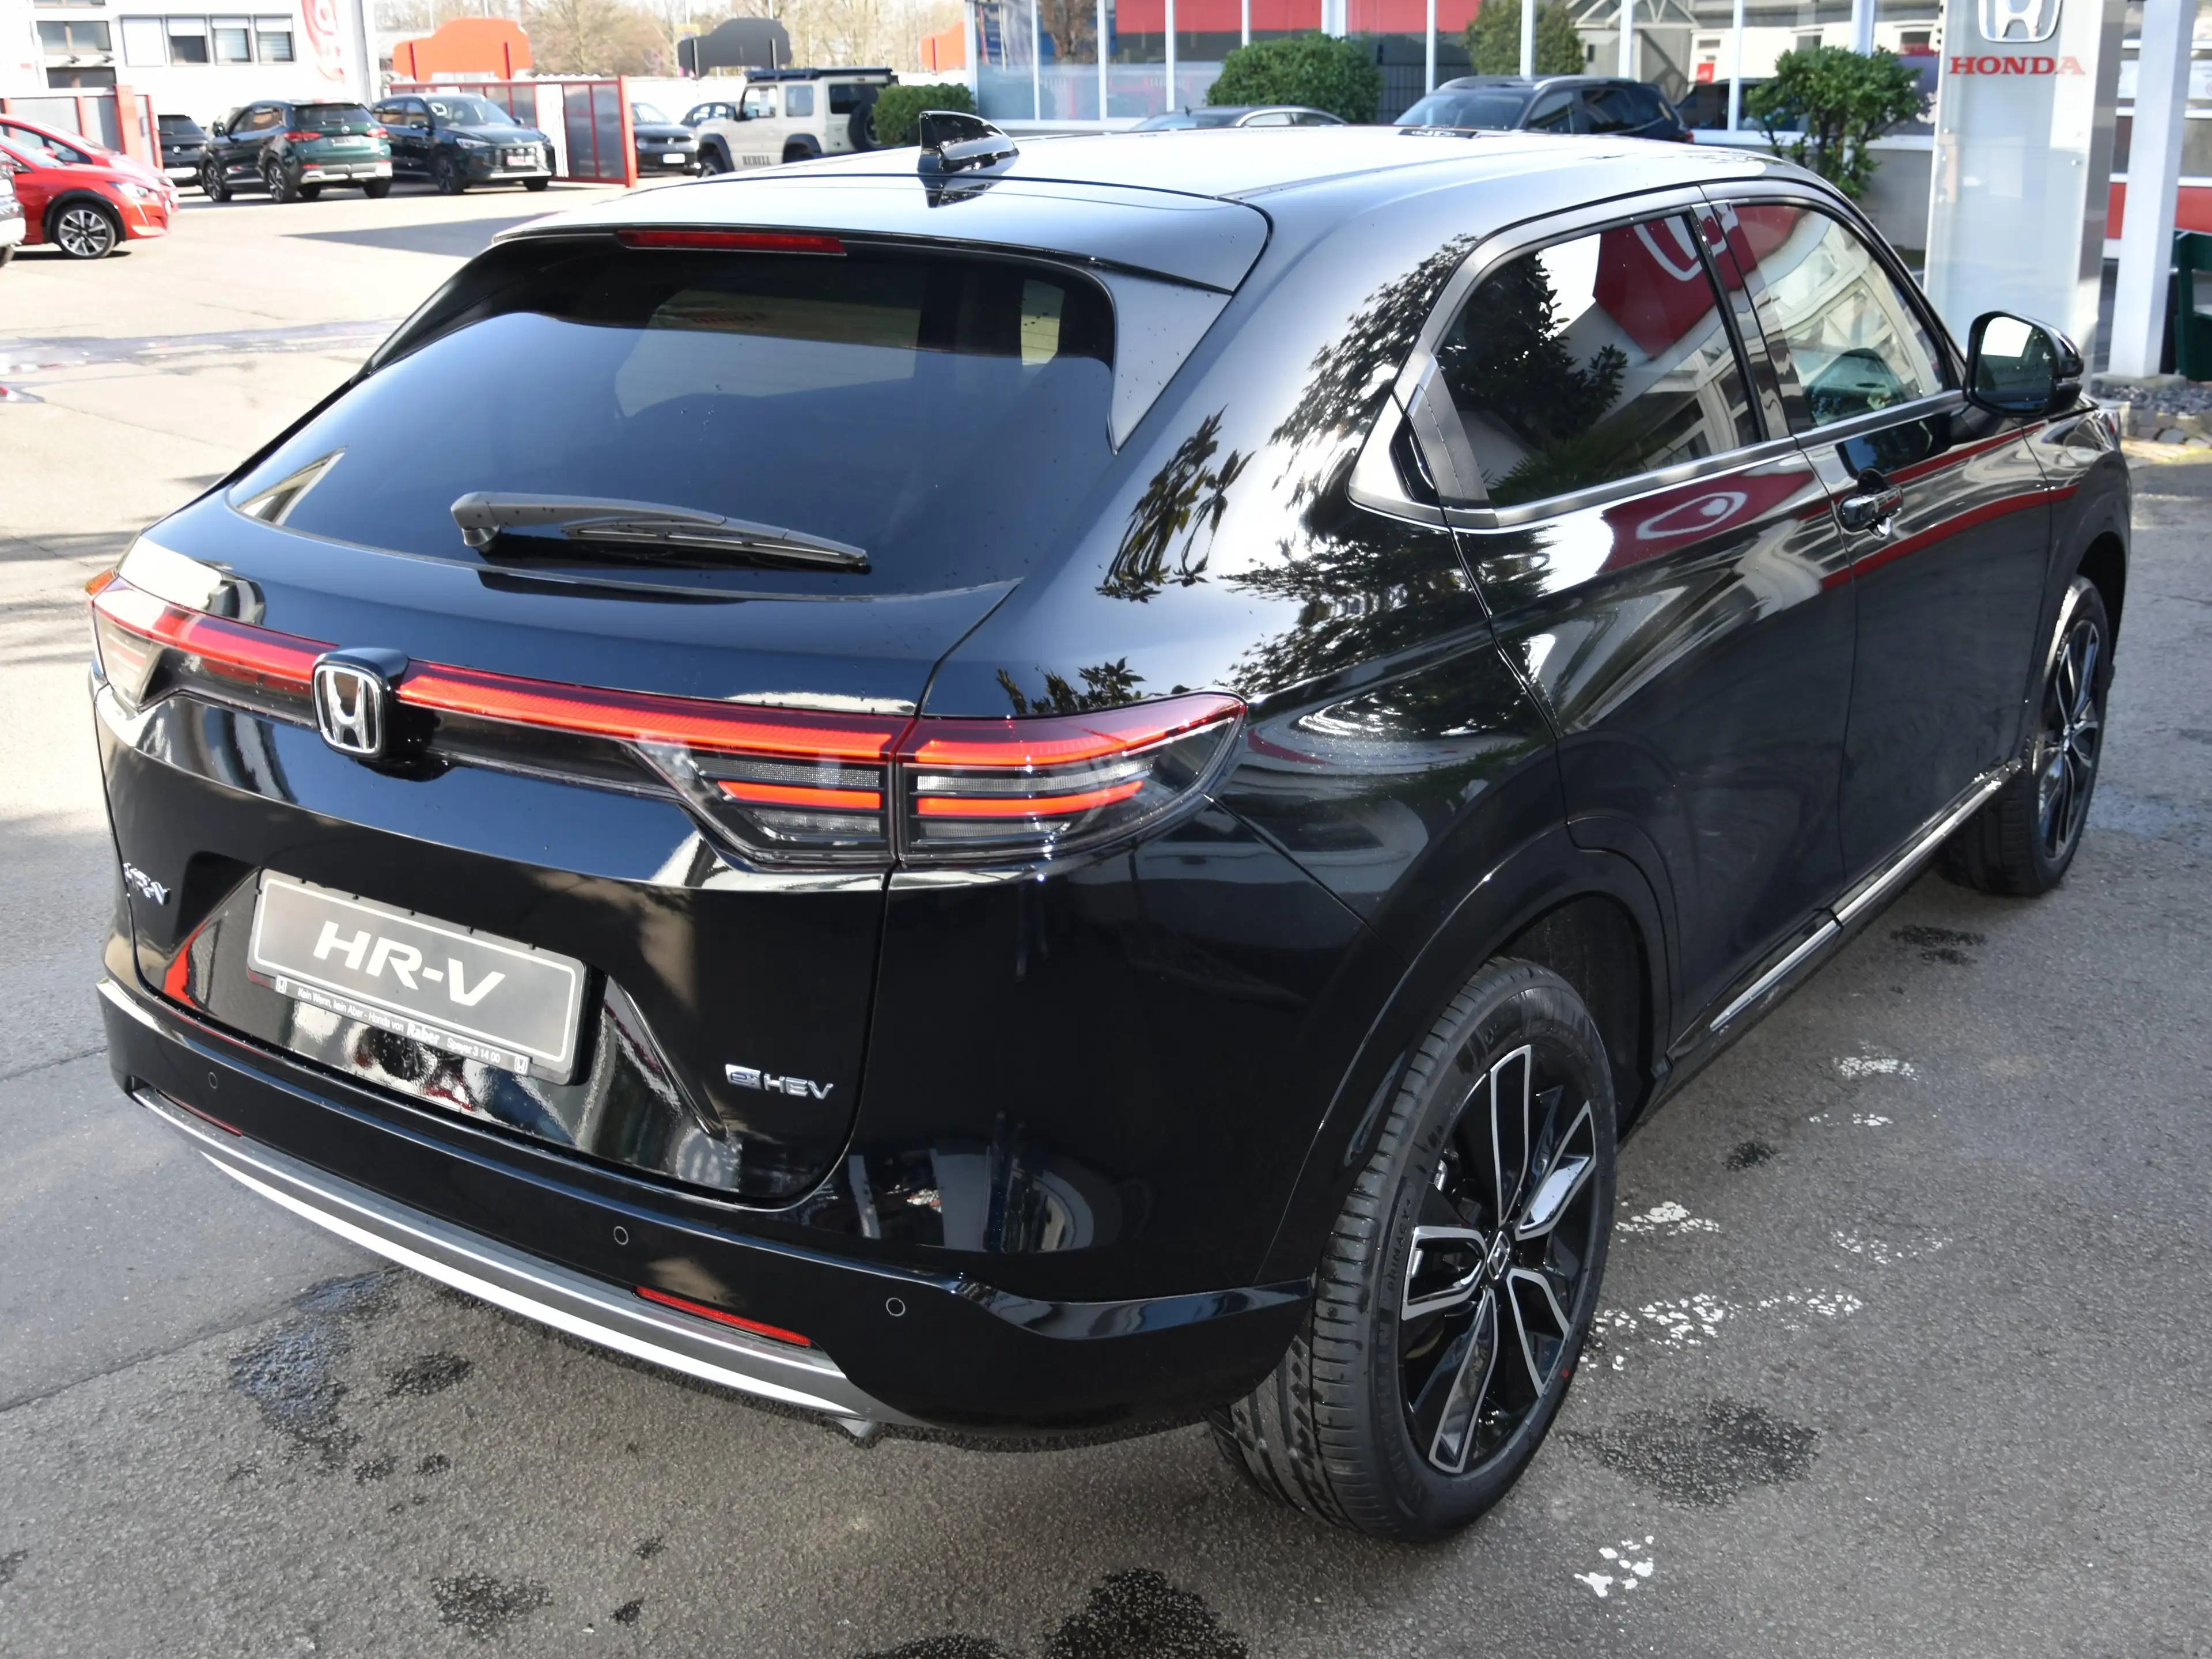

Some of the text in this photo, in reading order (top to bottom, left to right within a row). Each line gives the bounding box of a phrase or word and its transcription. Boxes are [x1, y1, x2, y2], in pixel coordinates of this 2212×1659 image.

[1949, 56, 2085, 75] HONDA
[313, 920, 506, 1006] HR-V
[298, 987, 312, 1001] Kein
[313, 991, 332, 1007] Wenn,
[334, 999, 347, 1013] kein
[347, 1004, 363, 1018] Aber
[369, 1012, 391, 1028] Honda
[392, 1021, 404, 1032] von
[447, 1037, 472, 1054] Speyer
[1384, 1207, 1410, 1292] PRIMACY
